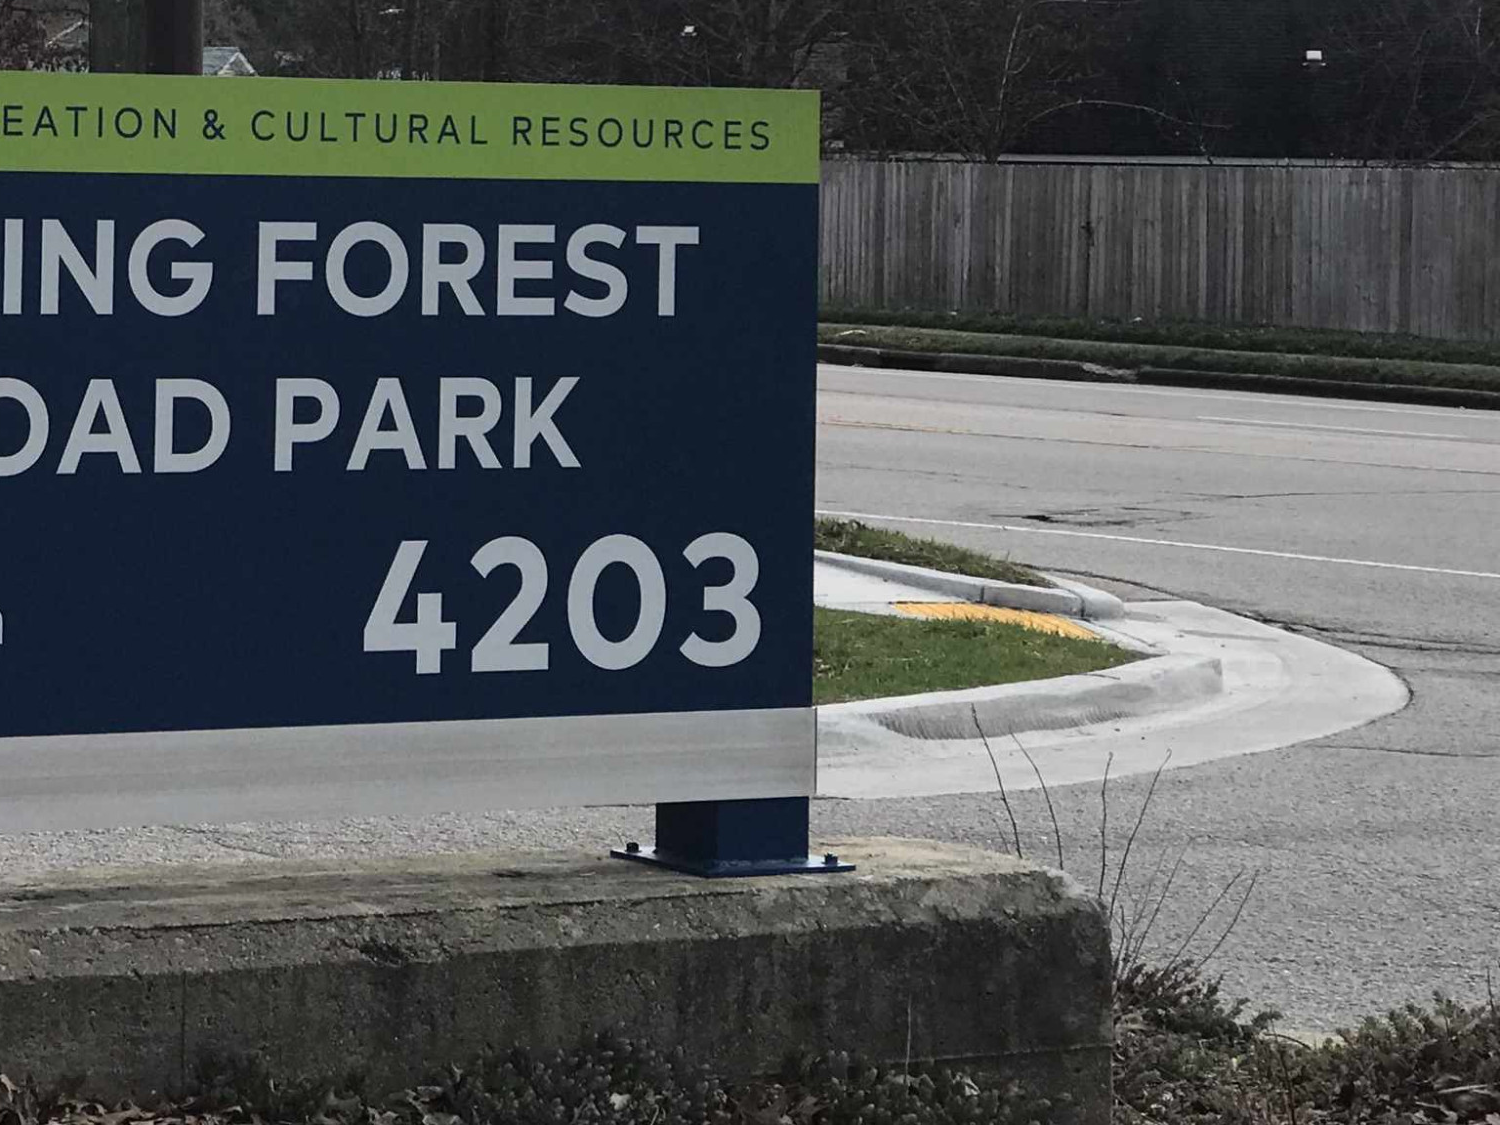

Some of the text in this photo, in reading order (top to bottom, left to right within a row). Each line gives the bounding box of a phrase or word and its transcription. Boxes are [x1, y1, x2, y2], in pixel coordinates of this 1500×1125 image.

[201, 109, 227, 141] &
[250, 110, 488, 145] CULTURAL
[512, 116, 771, 151] RESOURCES
[256, 220, 700, 318] FOREST
[273, 376, 582, 472] PARK
[363, 531, 762, 675] 4203
